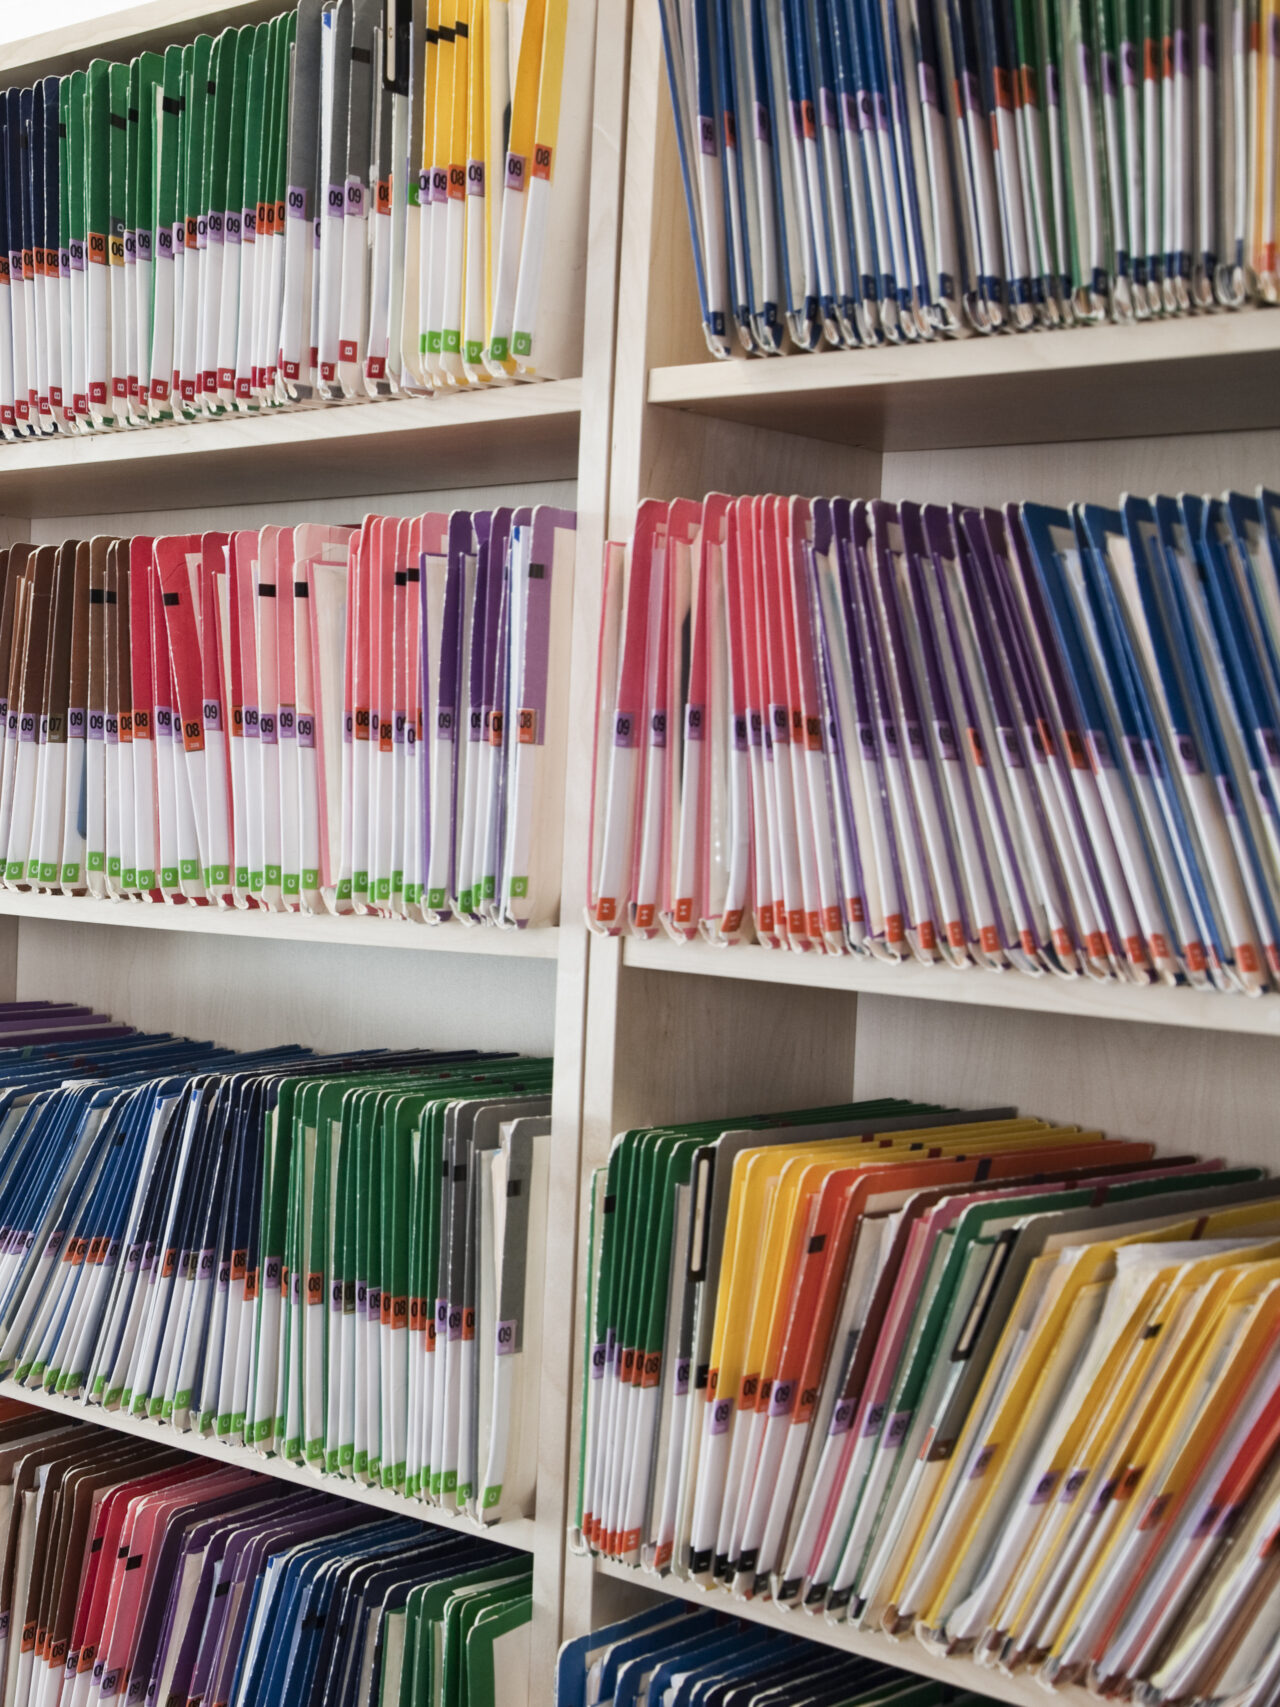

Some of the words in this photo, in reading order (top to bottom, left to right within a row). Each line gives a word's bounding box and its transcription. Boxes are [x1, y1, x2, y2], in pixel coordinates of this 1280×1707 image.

[536, 148, 550, 166] 08
[469, 165, 483, 181] 09
[509, 158, 522, 176] 09
[434, 173, 446, 190] 09
[451, 169, 465, 186] 08
[289, 192, 304, 208] 09
[330, 191, 344, 207] 09
[348, 187, 361, 203] 09
[209, 216, 222, 231] 09
[227, 218, 240, 233] 09
[91, 238, 103, 251] 08
[138, 234, 152, 249] 09
[159, 233, 172, 248] 09
[71, 245, 83, 259] 09
[112, 242, 124, 257] 06
[47, 253, 58, 267] 08
[0, 261, 9, 275] 08
[448, 336, 455, 345] C
[518, 340, 525, 350] C
[345, 347, 352, 355] B
[372, 364, 378, 372] B
[224, 373, 231, 381] B
[94, 388, 100, 396] B
[71, 712, 83, 726] 09
[135, 712, 148, 726] 08
[158, 711, 171, 726] 09
[204, 705, 218, 719] 09
[245, 711, 258, 724] 09
[356, 711, 369, 727] 08
[22, 718, 33, 731] 09
[50, 719, 61, 731] 07
[90, 716, 103, 729] 09
[106, 719, 117, 733] 09
[261, 718, 274, 732] 09
[280, 713, 293, 727] 09
[186, 723, 200, 737] 08
[298, 720, 312, 735] 09
[381, 724, 392, 739] 08
[92, 857, 99, 865] C
[44, 868, 52, 876] C
[184, 864, 192, 873] C
[164, 872, 172, 881] C
[306, 874, 313, 882] C
[288, 880, 295, 888] C
[234, 1252, 246, 1267] 08
[267, 1263, 278, 1278] 09
[309, 1277, 320, 1291] 08
[394, 1300, 406, 1315] 08
[450, 1312, 461, 1328] 09
[499, 1327, 512, 1343] 09
[23, 1628, 34, 1641] 08
[53, 1645, 64, 1657] 08
[83, 1646, 94, 1659] 08
[67, 1654, 79, 1669] 09
[103, 1675, 116, 1690] 09
